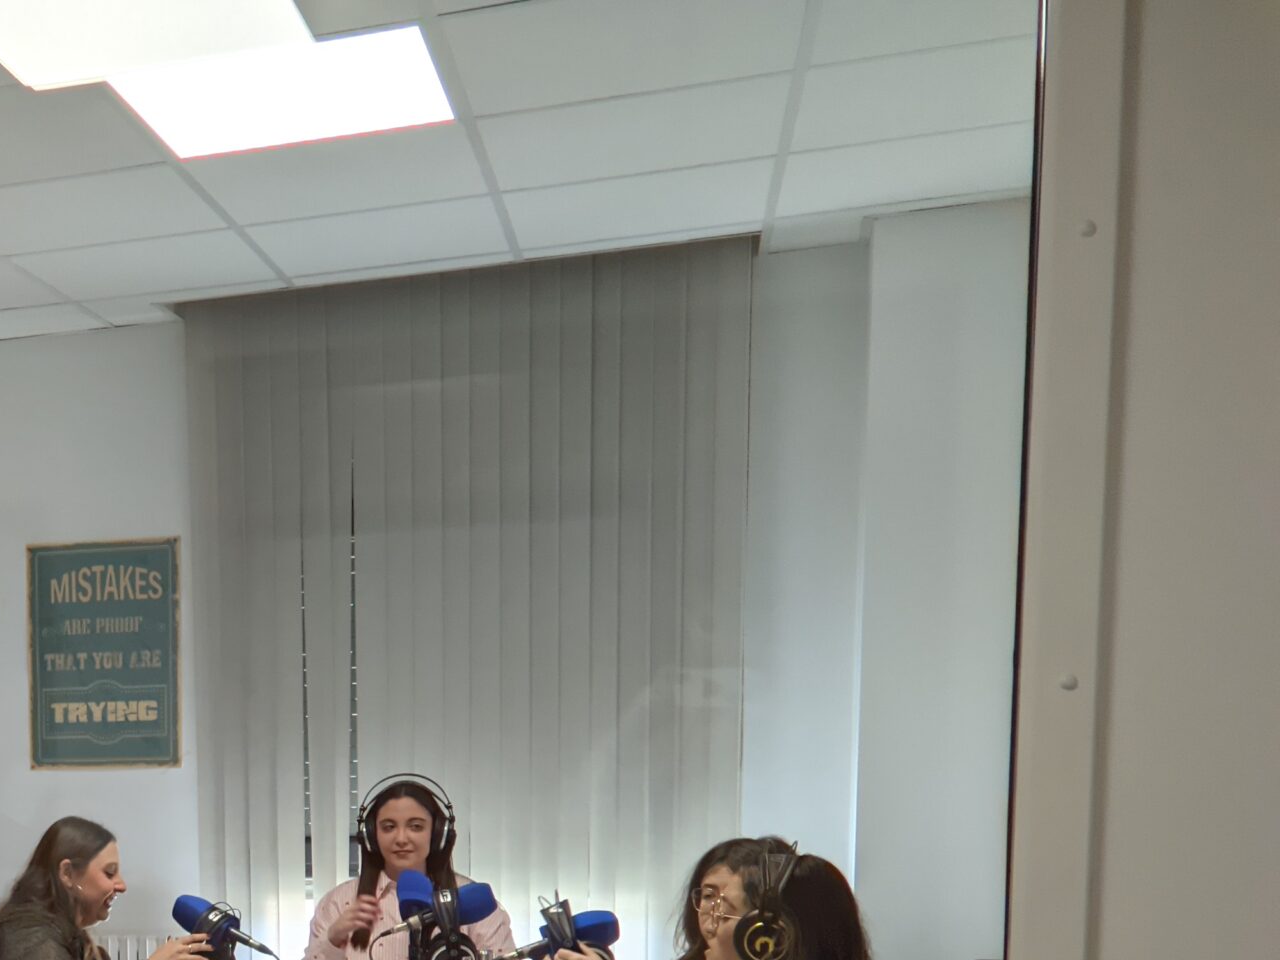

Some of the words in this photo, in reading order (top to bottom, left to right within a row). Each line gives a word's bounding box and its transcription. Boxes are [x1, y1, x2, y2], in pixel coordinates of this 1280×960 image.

[50, 565, 163, 604] MISTAKES
[63, 618, 91, 635] ARE
[96, 617, 143, 634] PROOF
[44, 651, 88, 671] THAT
[93, 651, 123, 670] YOU
[129, 650, 162, 668] ARE
[51, 700, 158, 723] TRYING
